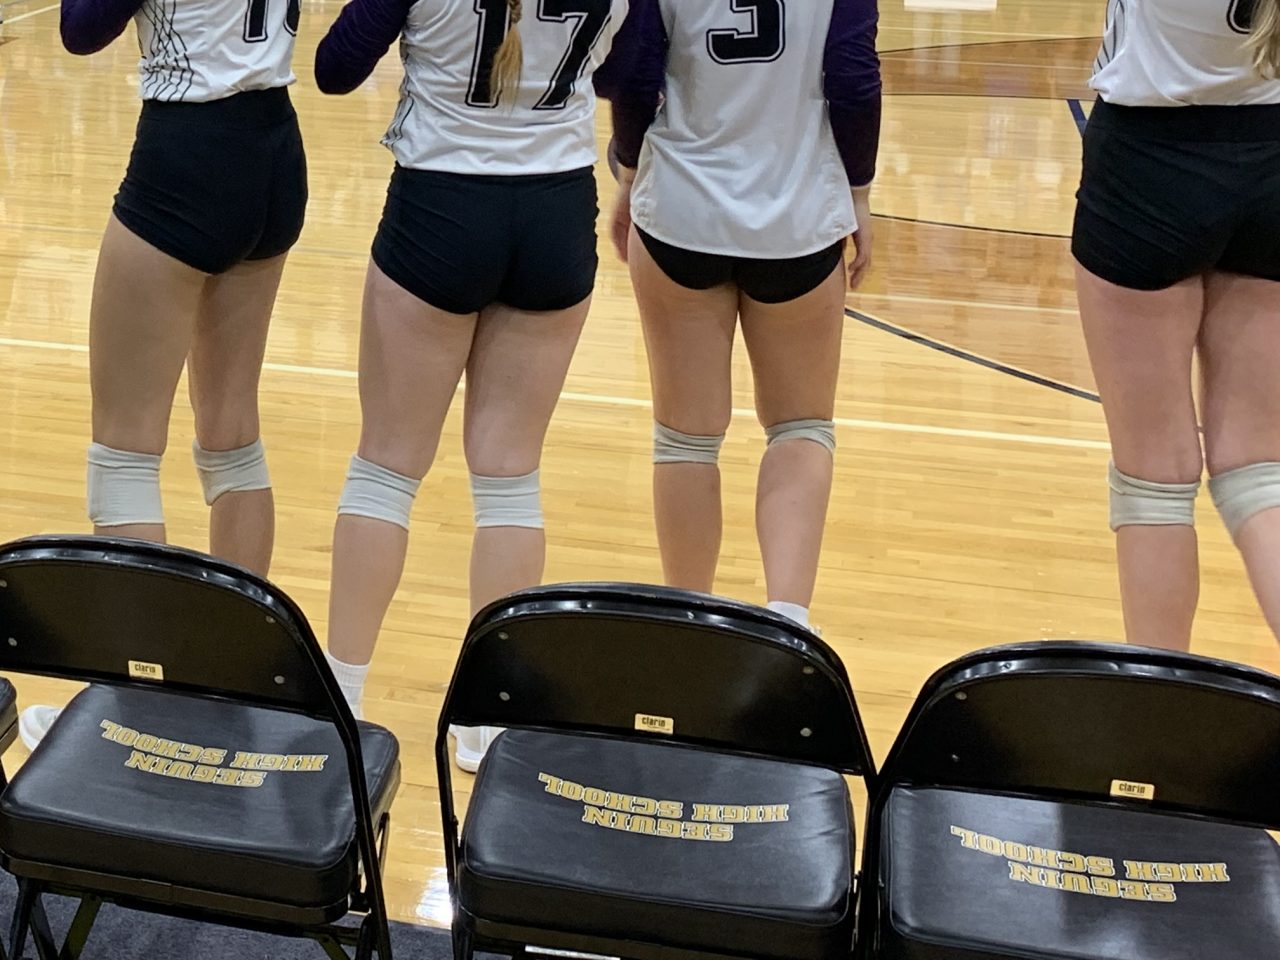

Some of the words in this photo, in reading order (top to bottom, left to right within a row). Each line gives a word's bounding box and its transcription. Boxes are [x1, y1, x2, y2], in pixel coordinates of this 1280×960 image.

[134, 663, 156, 673] clarin
[641, 717, 665, 727] clarin
[100, 719, 227, 765] SCHOOL
[124, 750, 268, 787] SEGUIN
[229, 751, 328, 771] HIGH
[538, 772, 683, 818] SCHOOL
[1118, 783, 1146, 794] clarin
[581, 805, 734, 841] SEGUIN
[691, 804, 789, 823] HIGH
[950, 825, 1115, 877] SCHOOL
[1008, 861, 1177, 902] SEGUIN
[1123, 860, 1230, 882] HIGH
